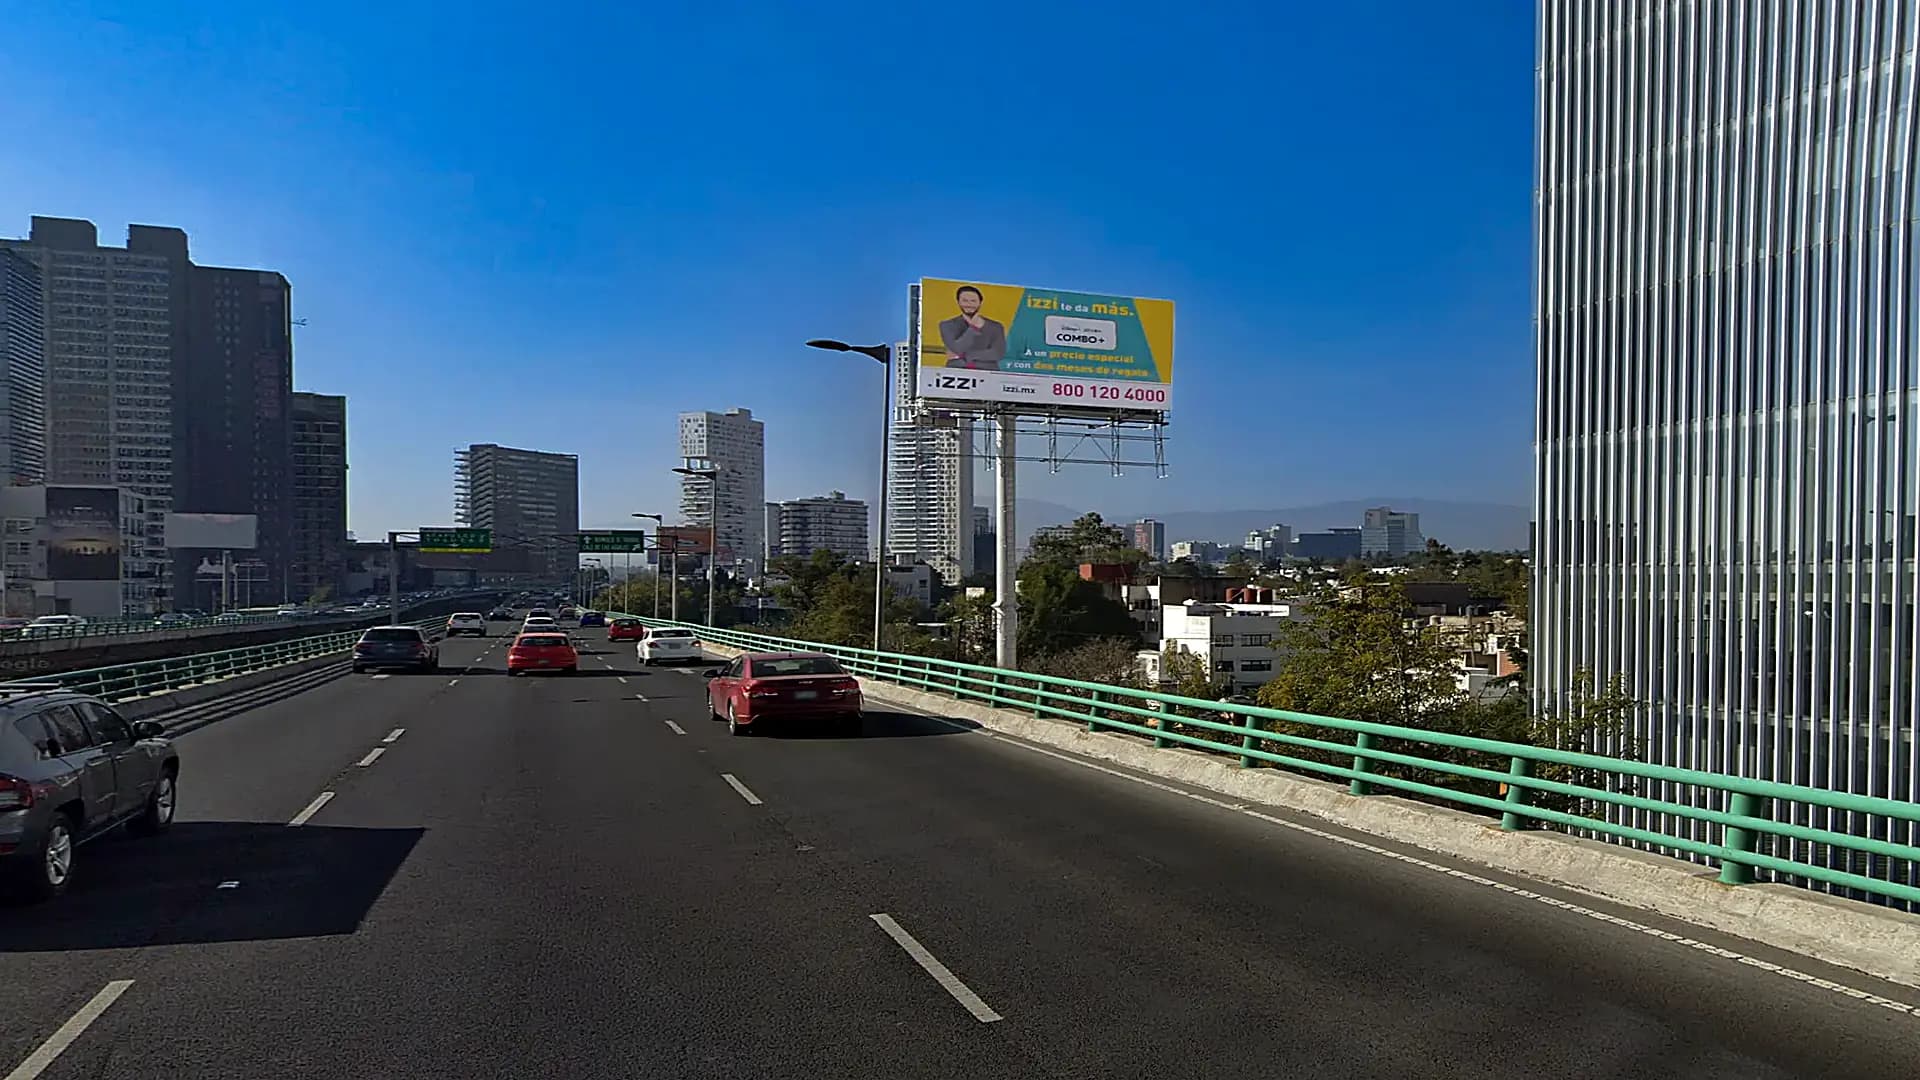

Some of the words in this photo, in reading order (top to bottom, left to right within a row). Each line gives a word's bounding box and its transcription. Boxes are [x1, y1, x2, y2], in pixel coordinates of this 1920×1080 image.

[1027, 293, 1059, 310] izzi
[1061, 302, 1072, 312] te
[1075, 303, 1089, 313] da
[1056, 333, 1105, 344] COMBO+
[1025, 347, 1033, 357] A
[1034, 350, 1047, 358] un
[1049, 350, 1086, 360] precio
[1087, 353, 1135, 364] especial
[1014, 361, 1031, 369] con
[1002, 384, 1036, 395] izzi.mx
[1052, 382, 1084, 398] 800
[1090, 385, 1120, 400] 120
[1124, 387, 1166, 403] 4000
